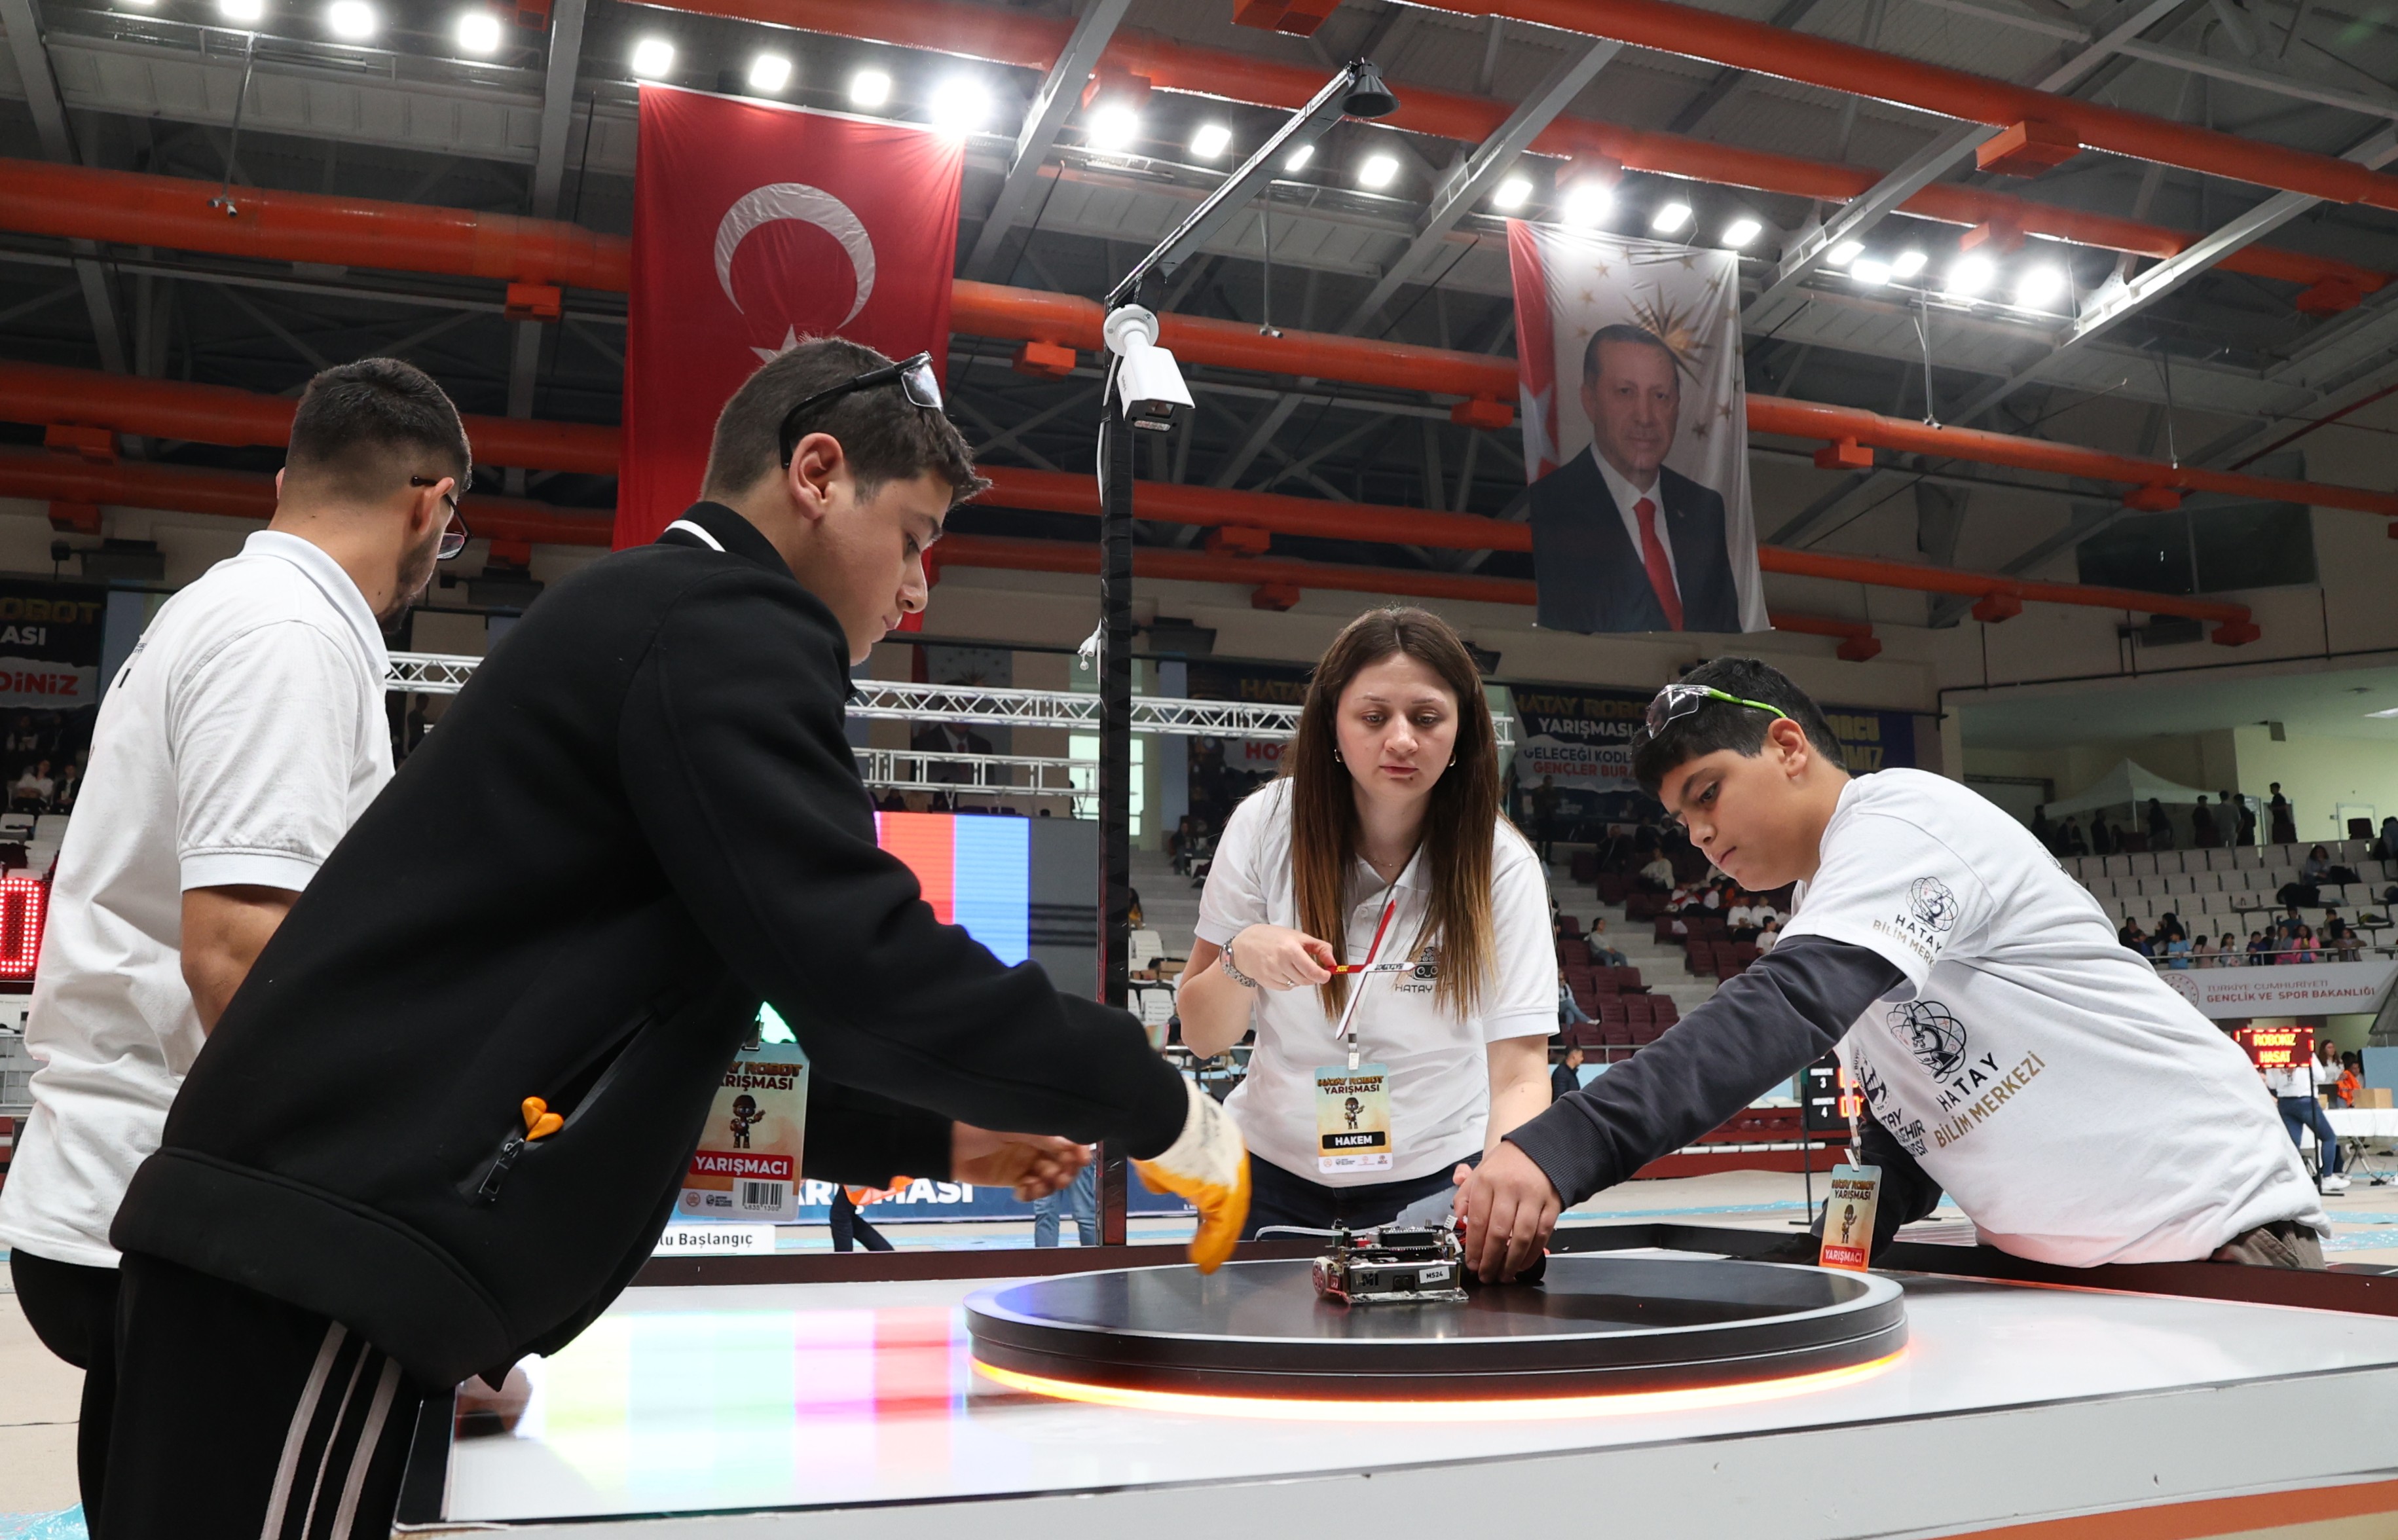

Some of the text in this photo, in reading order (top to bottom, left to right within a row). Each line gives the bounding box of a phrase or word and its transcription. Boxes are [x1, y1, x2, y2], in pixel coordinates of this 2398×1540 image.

[1538, 718, 1634, 739] YARIŞMASI
[1533, 761, 1596, 778] GENÇLER
[1895, 914, 1943, 954] HATAY
[1872, 919, 1936, 970] BİLİM MERK
[1394, 983, 1433, 994] HATAY
[2206, 984, 2376, 1003] GENÇLİK VE SPOR BAKANLIĞI
[2259, 1050, 2291, 1063] HASAT
[744, 1061, 803, 1077] ROBOT
[1324, 1084, 1380, 1095] YARIŞMASI
[1820, 1077, 1826, 1088] 3
[1935, 1052, 1999, 1112] HATAY
[1933, 1050, 2046, 1148] BİLİM MERKEZİ
[1821, 1107, 1828, 1118] 4
[1879, 1108, 1902, 1129] TAY
[1335, 1135, 1373, 1146] HAKEM
[695, 1156, 788, 1176] YARIŞMACI
[1834, 1190, 1871, 1203] YARIŞMASI
[679, 1234, 753, 1249] Başlangıç
[1825, 1248, 1862, 1264] YARIŞMACI
